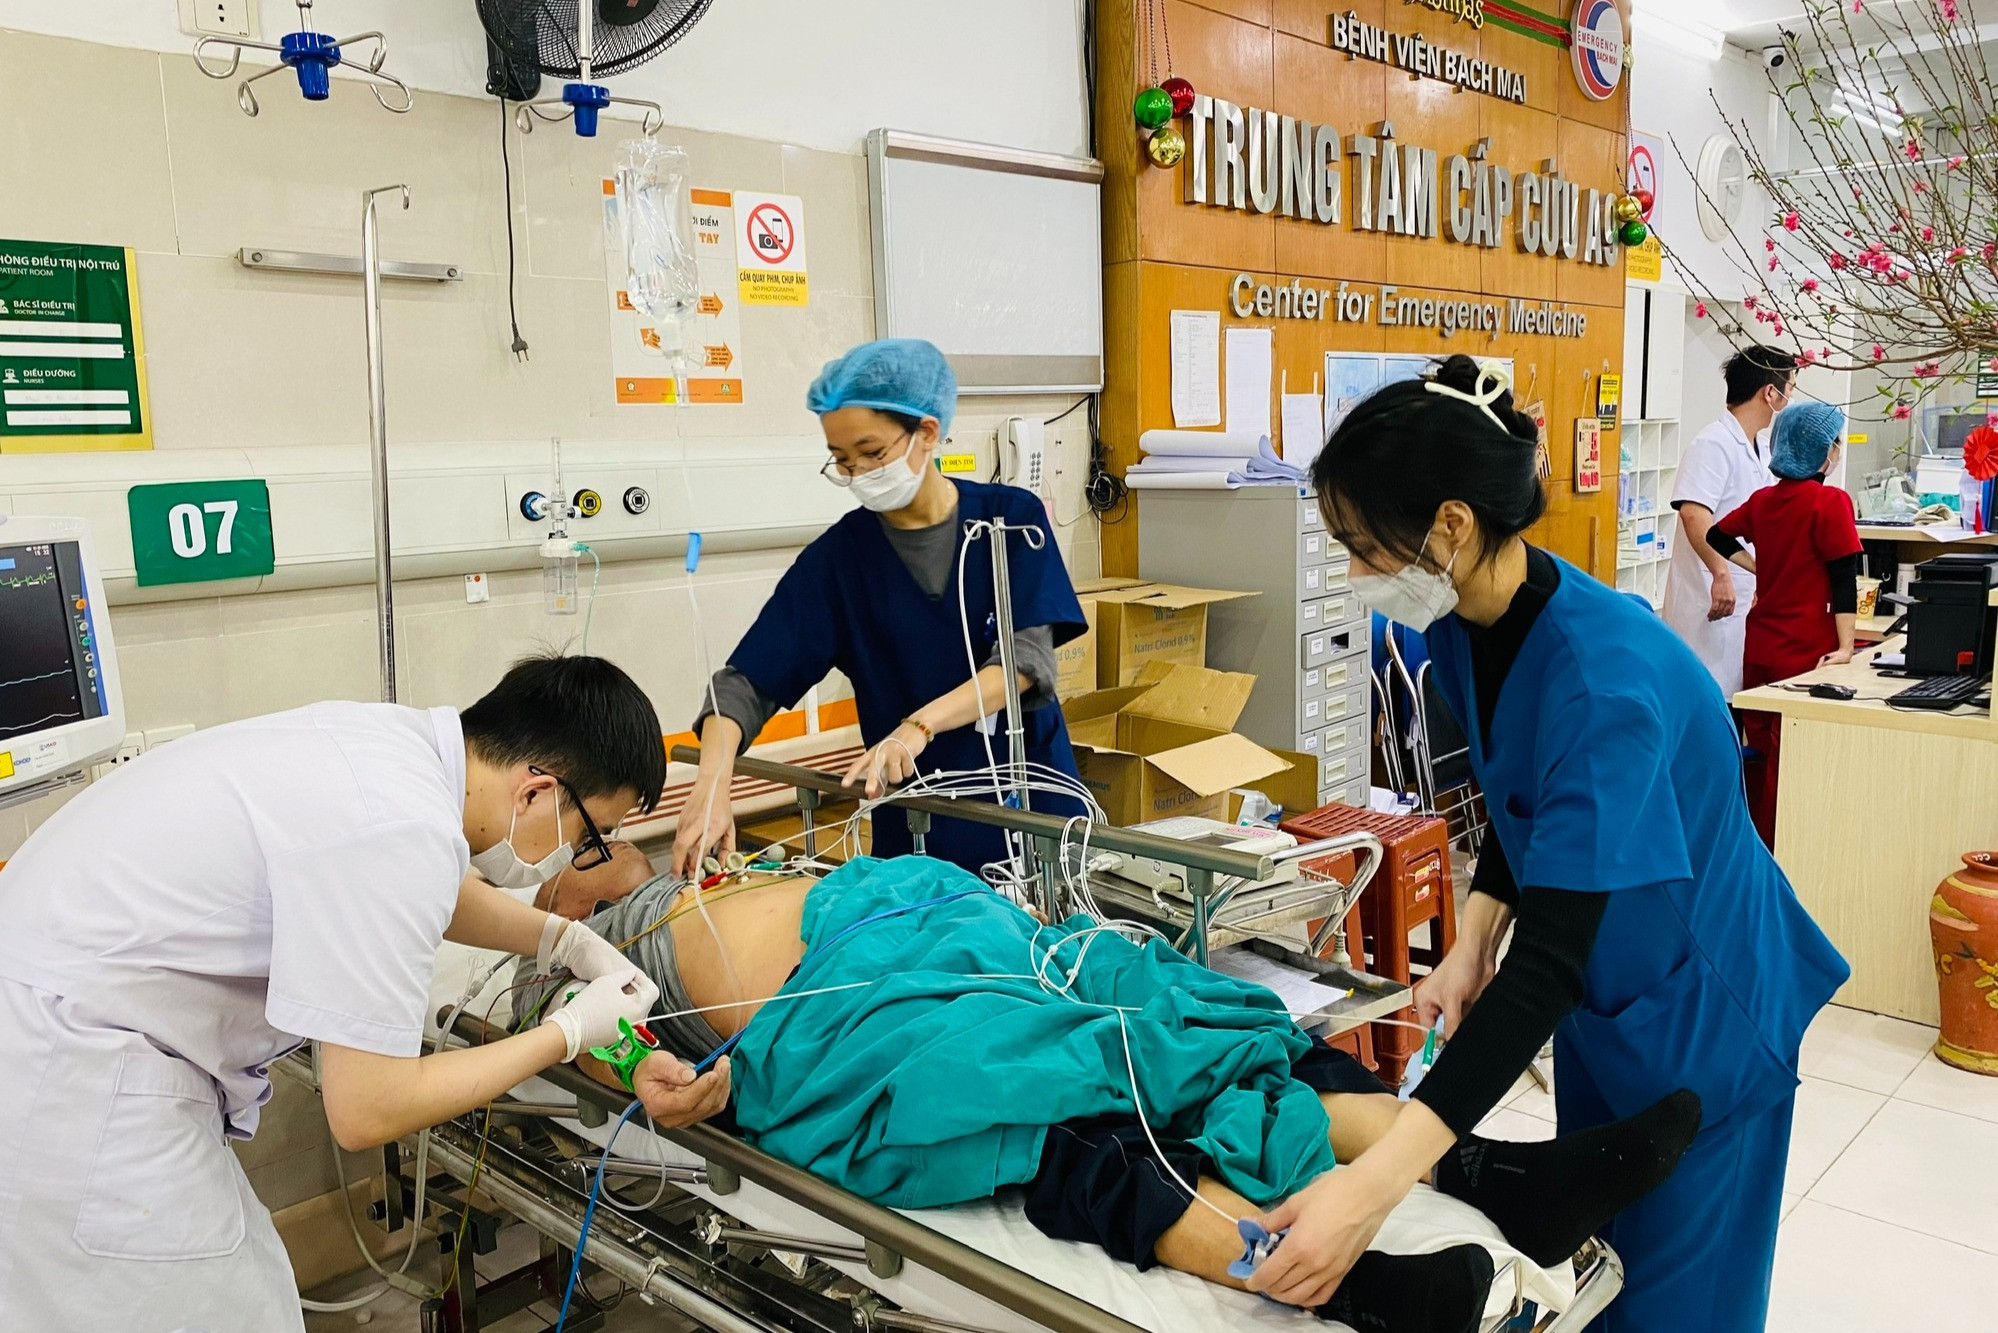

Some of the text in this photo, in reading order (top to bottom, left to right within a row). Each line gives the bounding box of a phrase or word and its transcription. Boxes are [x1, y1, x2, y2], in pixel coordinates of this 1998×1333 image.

[1577, 30, 1618, 53] EMERGENCY
[1332, 10, 1527, 103] BỆNH VIỆN BẠCH MAI
[1187, 92, 1341, 224] TRUNG
[1351, 120, 1438, 238] TÂM
[1448, 136, 1513, 248] CẤP
[1521, 157, 1579, 259] CỨU
[698, 232, 719, 244] TAY
[29, 268, 54, 276] ROOM
[78, 259, 98, 271] NỘI
[99, 260, 120, 271] TRÚ
[752, 273, 765, 283] QUAY
[766, 274, 781, 285] PHIM,
[13, 299, 31, 308] BÁC
[1231, 273, 1587, 341] Center for Emergency Medicine
[168, 500, 238, 558] 07
[1134, 642, 1153, 654] Natri
[1155, 637, 1177, 650] Clorid
[1065, 646, 1086, 662] 0,9%
[1153, 798, 1176, 812] Natri
